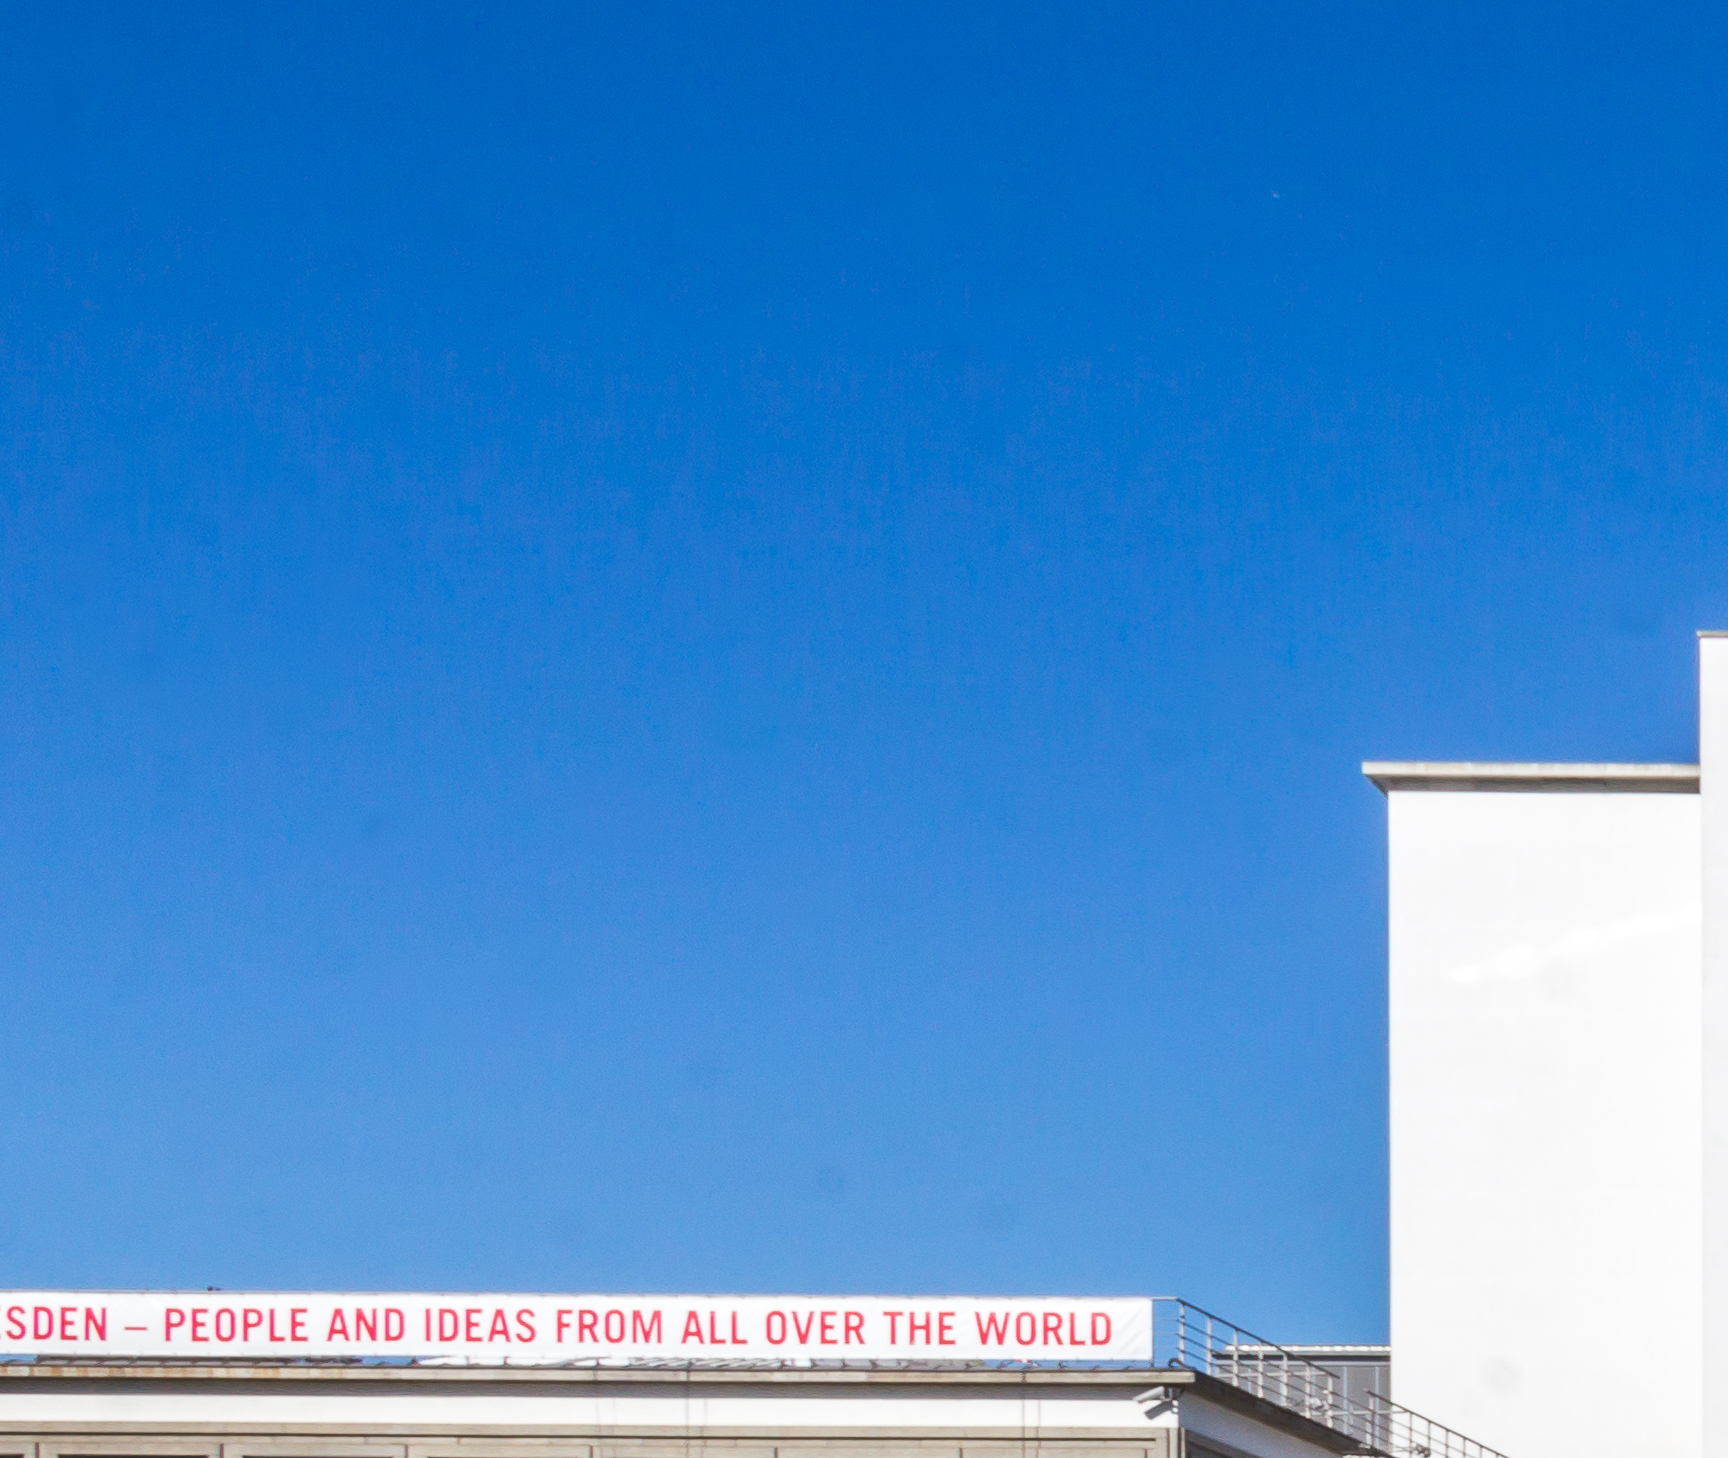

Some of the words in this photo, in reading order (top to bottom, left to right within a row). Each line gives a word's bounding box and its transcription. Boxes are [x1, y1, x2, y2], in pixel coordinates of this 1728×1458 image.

[0, 1306, 106, 1341] SDEN
[165, 1308, 307, 1342] PEOPLE
[327, 1308, 404, 1342] AND
[425, 1309, 536, 1343] IDEAS
[557, 1310, 661, 1344] FROM
[682, 1311, 747, 1344] ALL
[766, 1311, 864, 1345] OVER
[883, 1312, 955, 1345] THE
[975, 1312, 1111, 1346] WORLD
